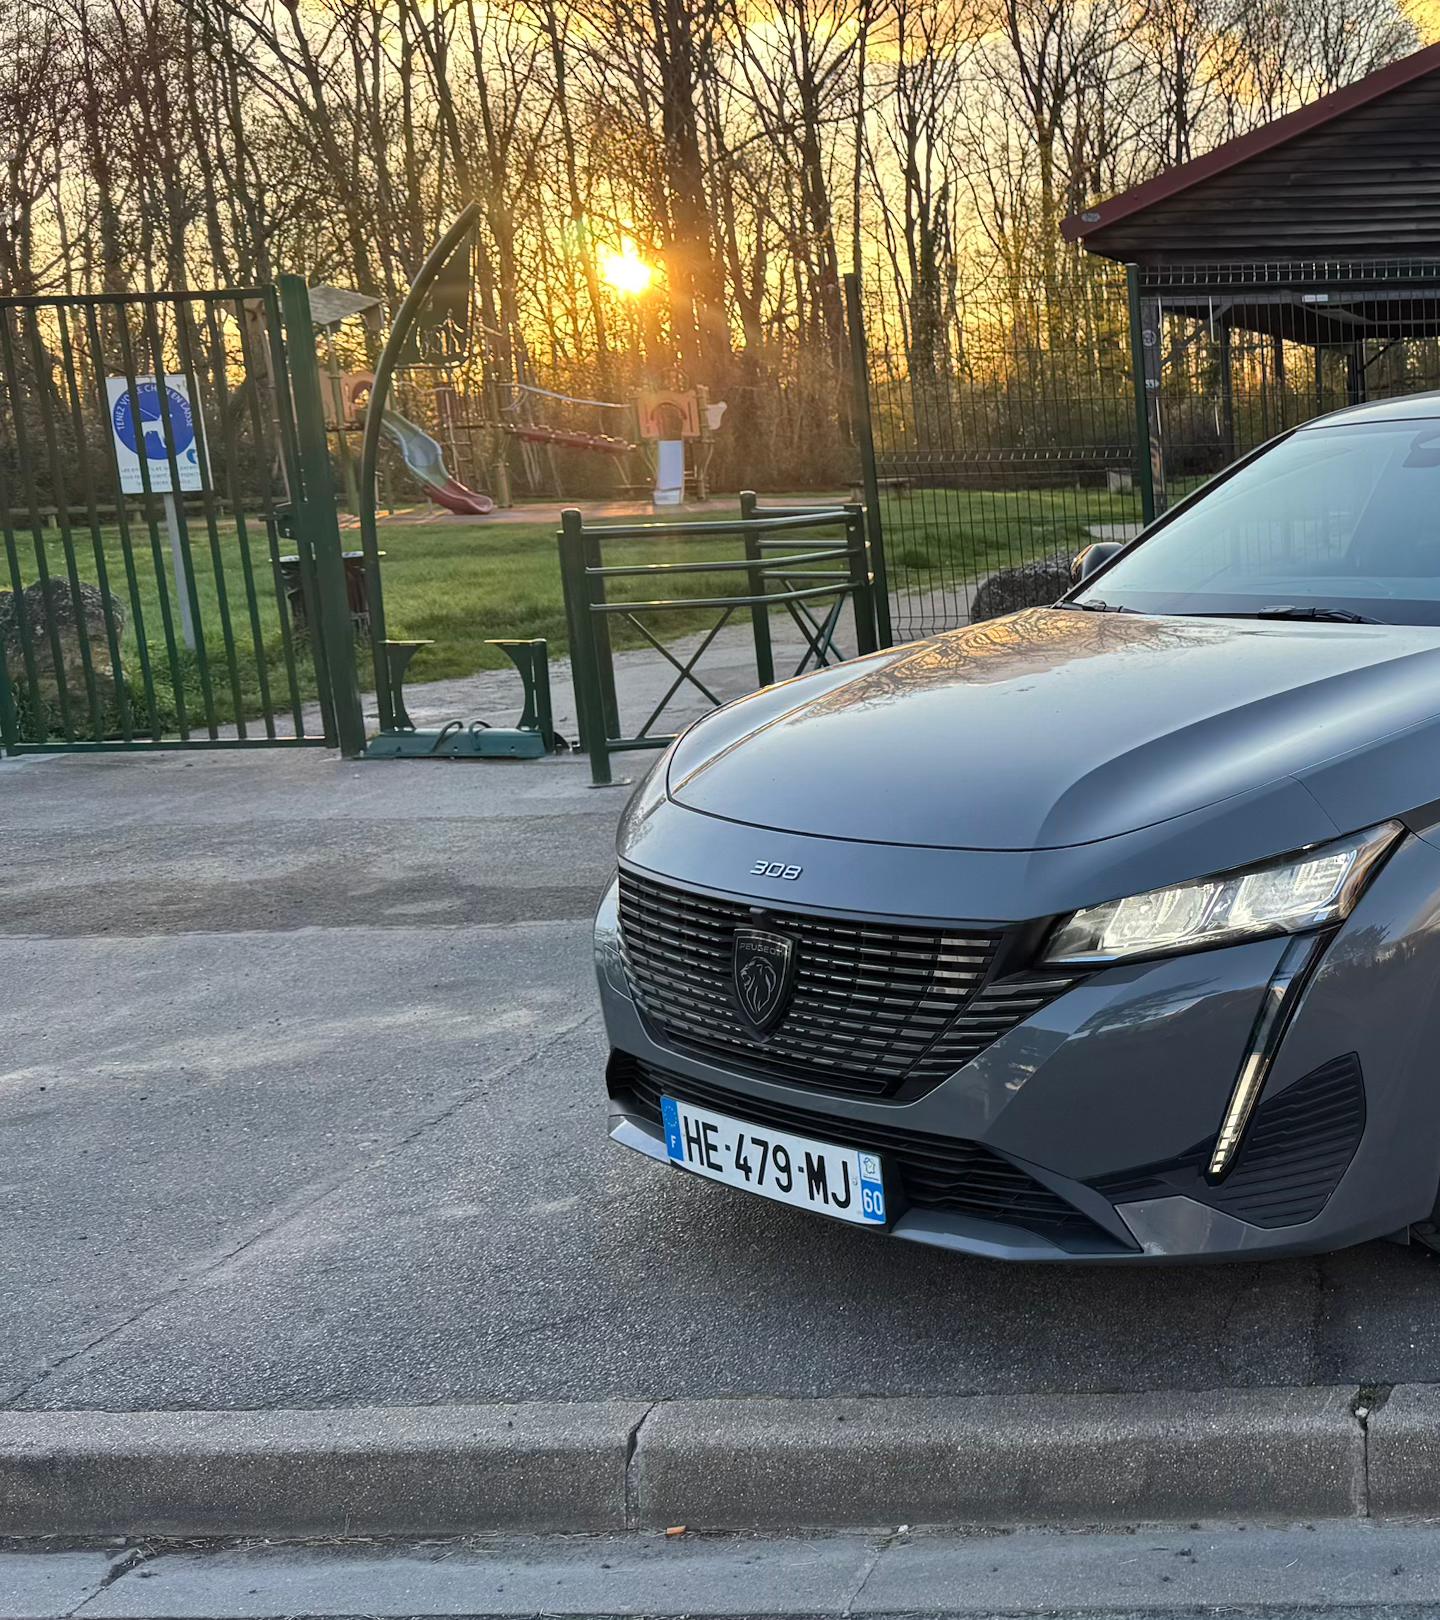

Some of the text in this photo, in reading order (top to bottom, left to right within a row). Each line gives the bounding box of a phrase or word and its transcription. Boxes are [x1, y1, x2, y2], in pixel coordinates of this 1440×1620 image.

[115, 406, 126, 431] TENEZ
[750, 860, 802, 880] 308
[739, 942, 783, 956] PEUGEOT
[670, 1115, 884, 1216] F HE-479-MJ 60
